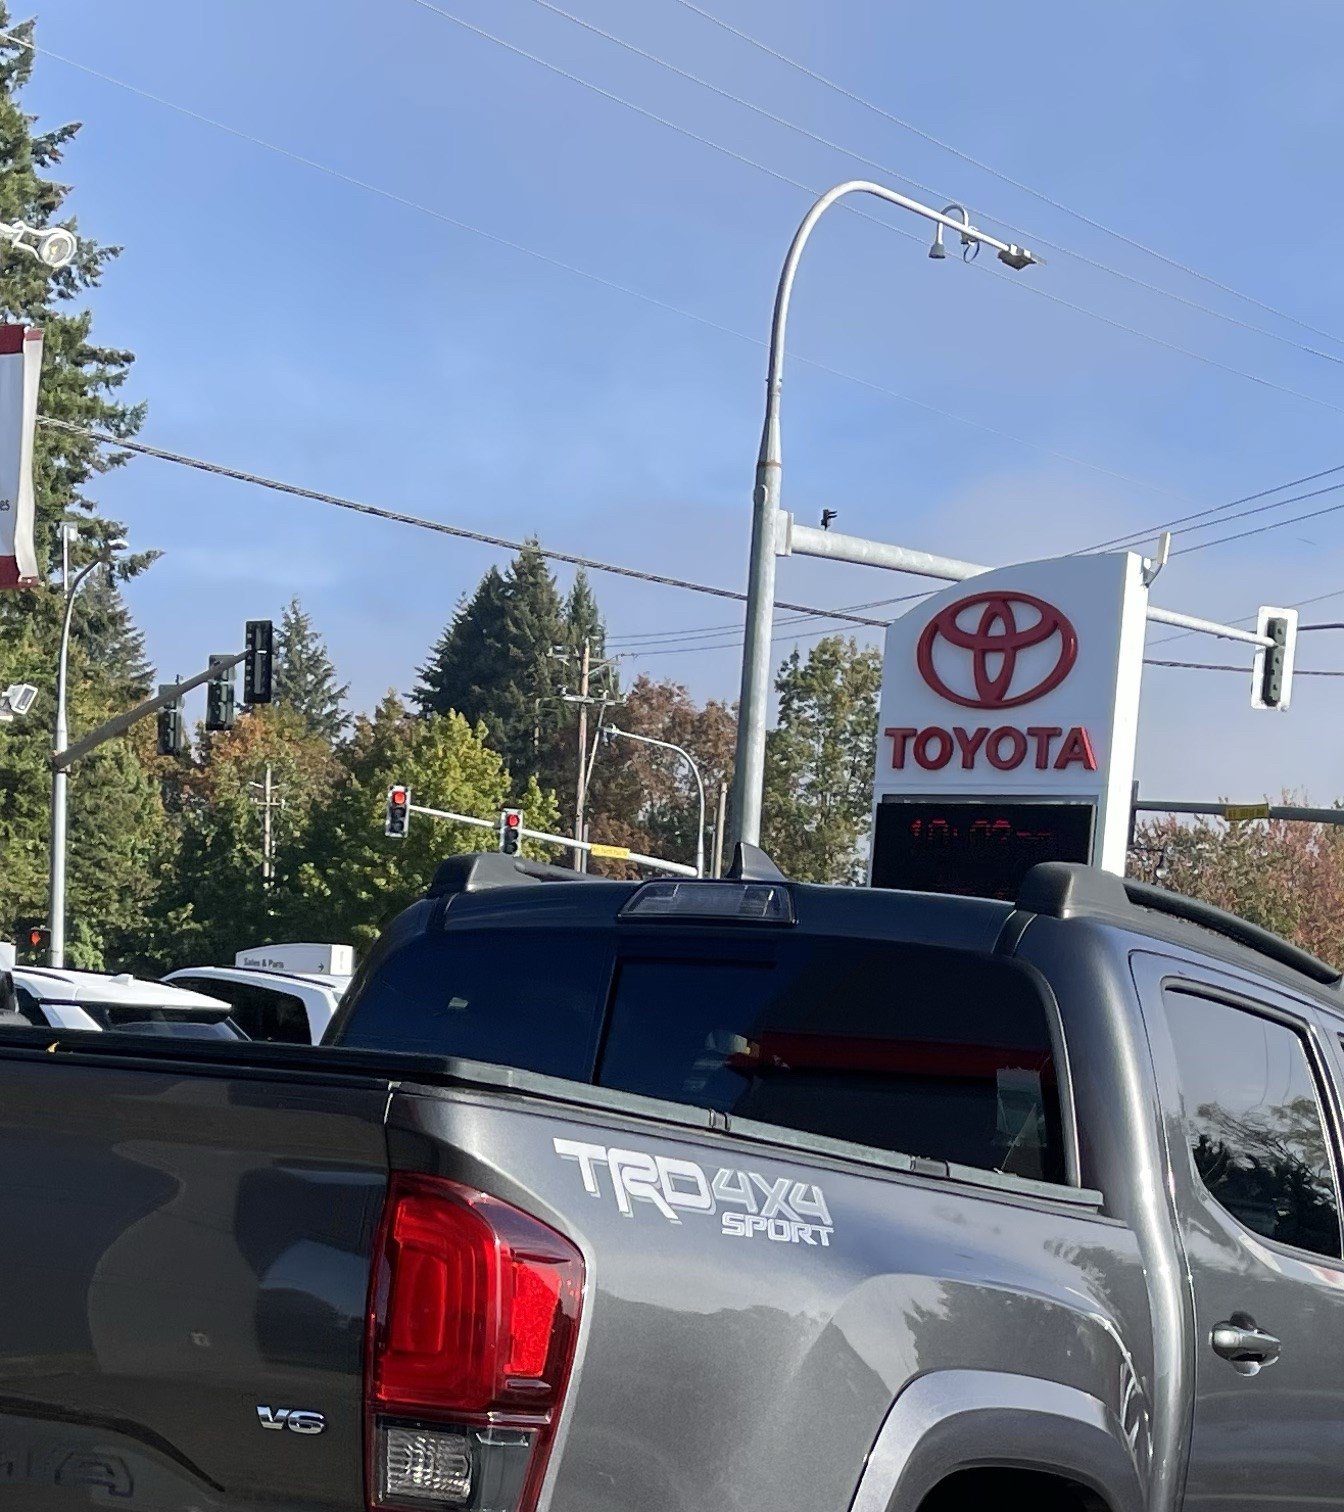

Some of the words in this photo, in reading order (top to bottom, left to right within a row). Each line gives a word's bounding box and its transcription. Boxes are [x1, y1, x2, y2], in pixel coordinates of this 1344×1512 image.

[884, 725, 1099, 772] TOYOTA
[243, 957, 261, 967] Sales
[552, 1137, 716, 1225] TRD
[721, 1210, 835, 1247] SPORT
[256, 1404, 326, 1435] V6
